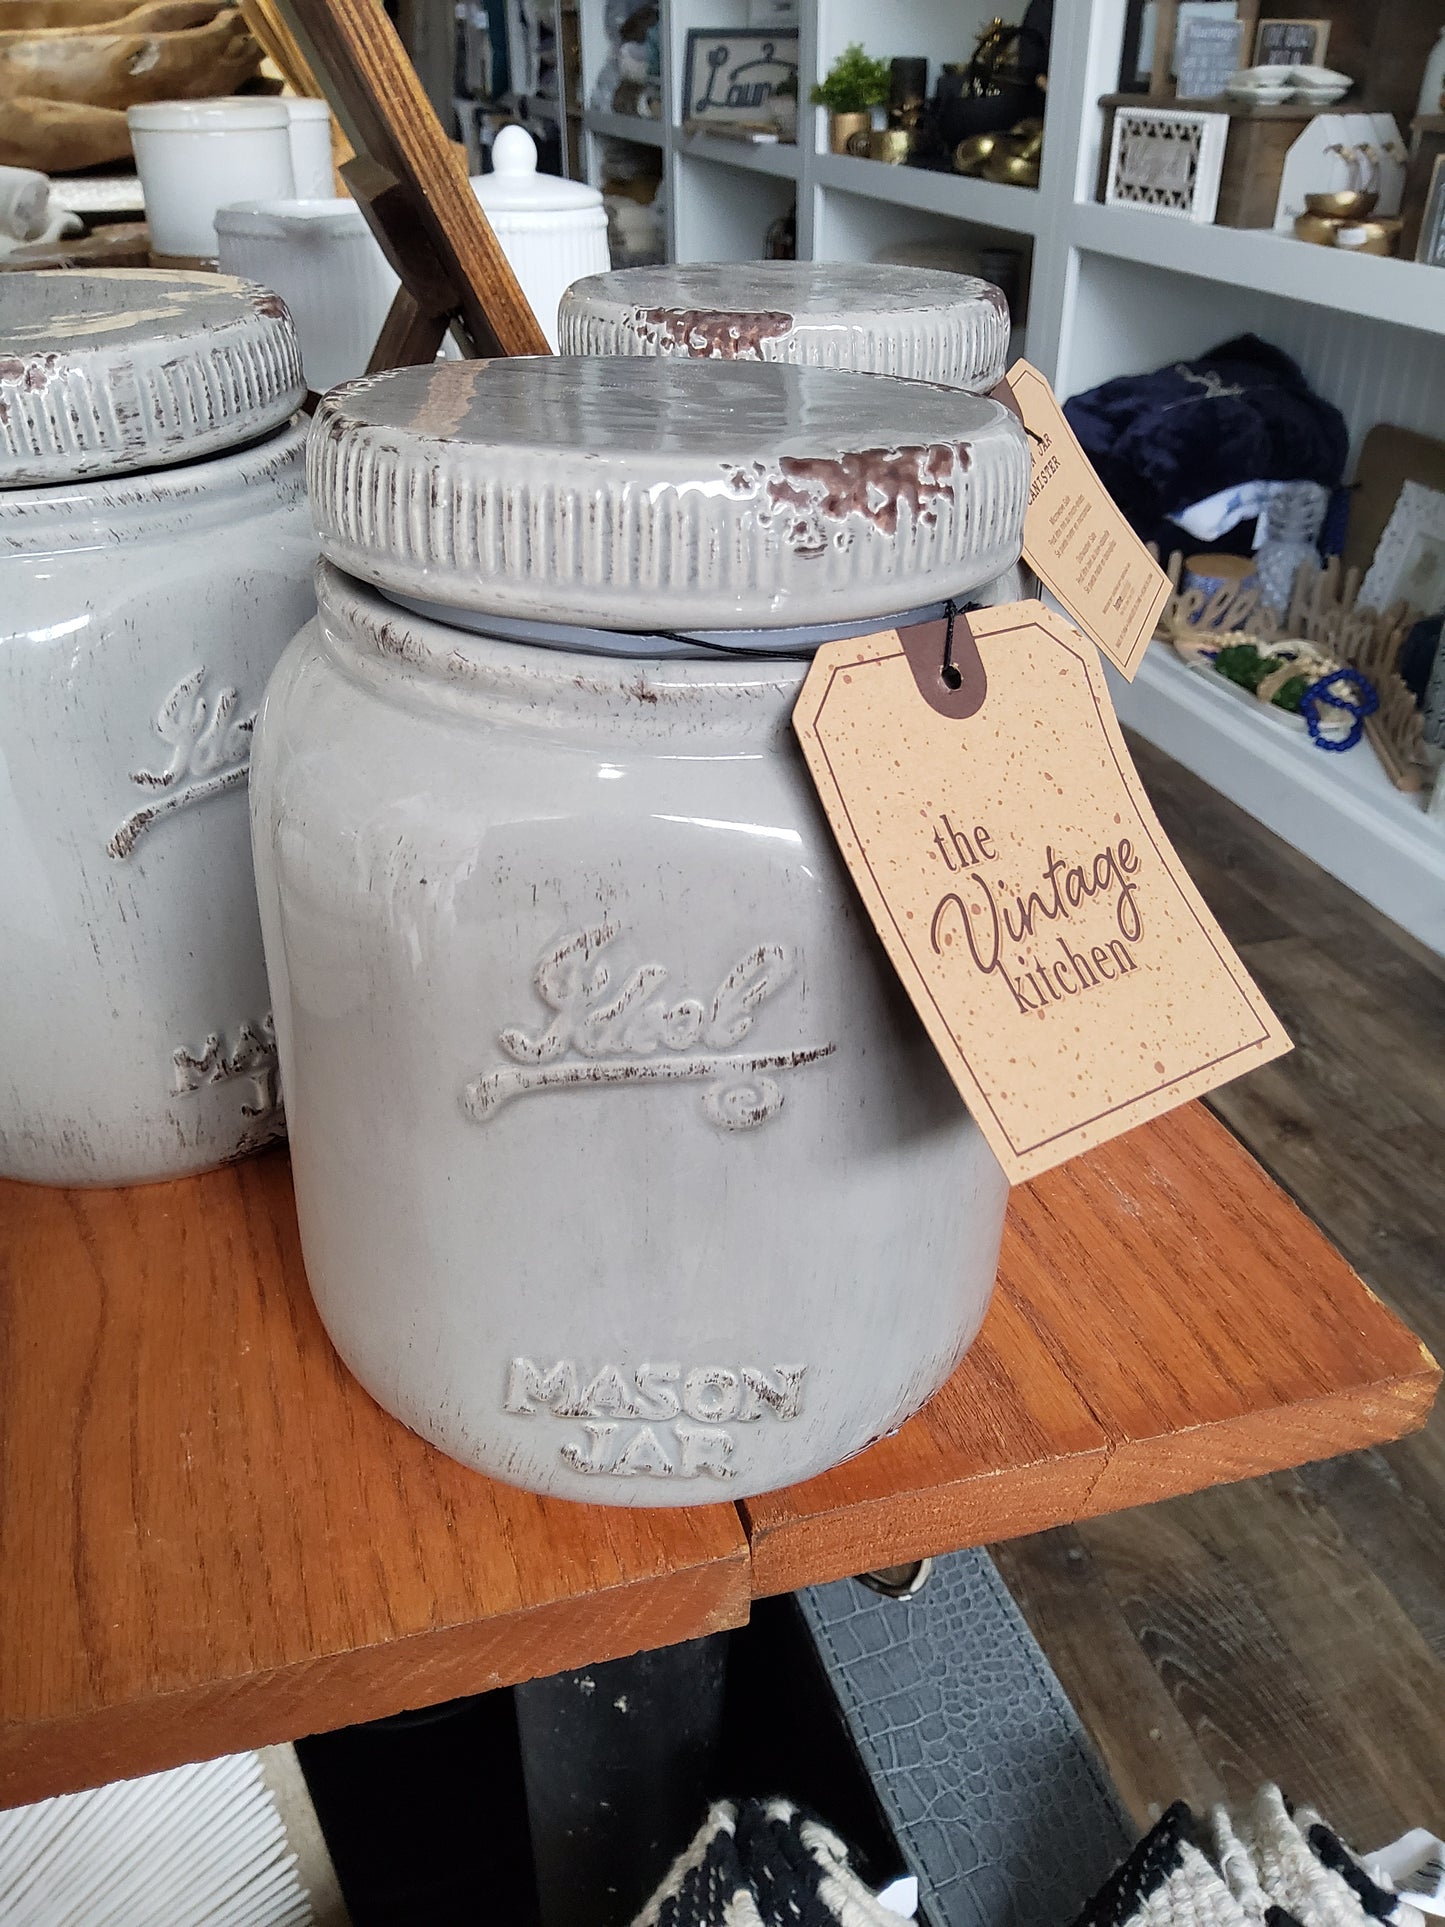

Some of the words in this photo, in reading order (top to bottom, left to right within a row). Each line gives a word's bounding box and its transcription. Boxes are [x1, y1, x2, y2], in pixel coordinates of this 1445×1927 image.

[932, 814, 997, 872] the
[930, 838, 1139, 975] Vintage
[996, 937, 1139, 1014] kitchen
[501, 1354, 808, 1424] MASON
[558, 1420, 738, 1480] JAR
